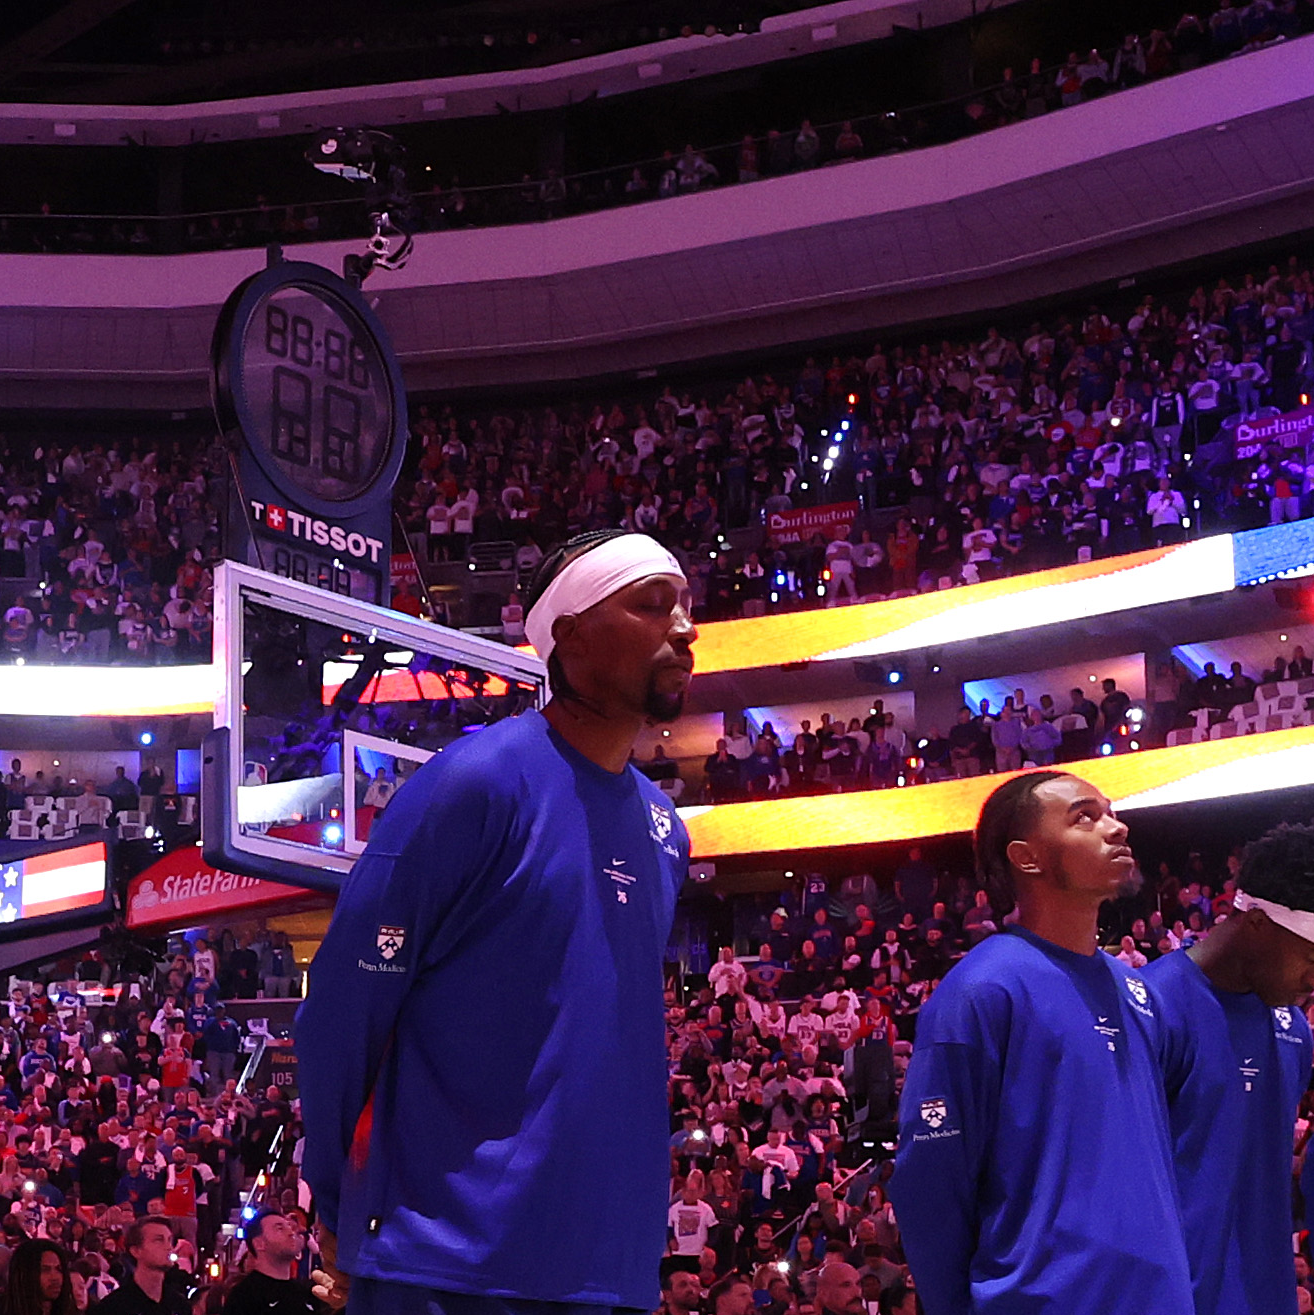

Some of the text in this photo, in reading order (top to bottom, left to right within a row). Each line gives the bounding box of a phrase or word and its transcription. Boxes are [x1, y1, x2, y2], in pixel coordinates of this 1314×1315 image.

[287, 513, 384, 563] TISSOT
[810, 882, 826, 894] 23
[271, 1071, 294, 1087] 105
